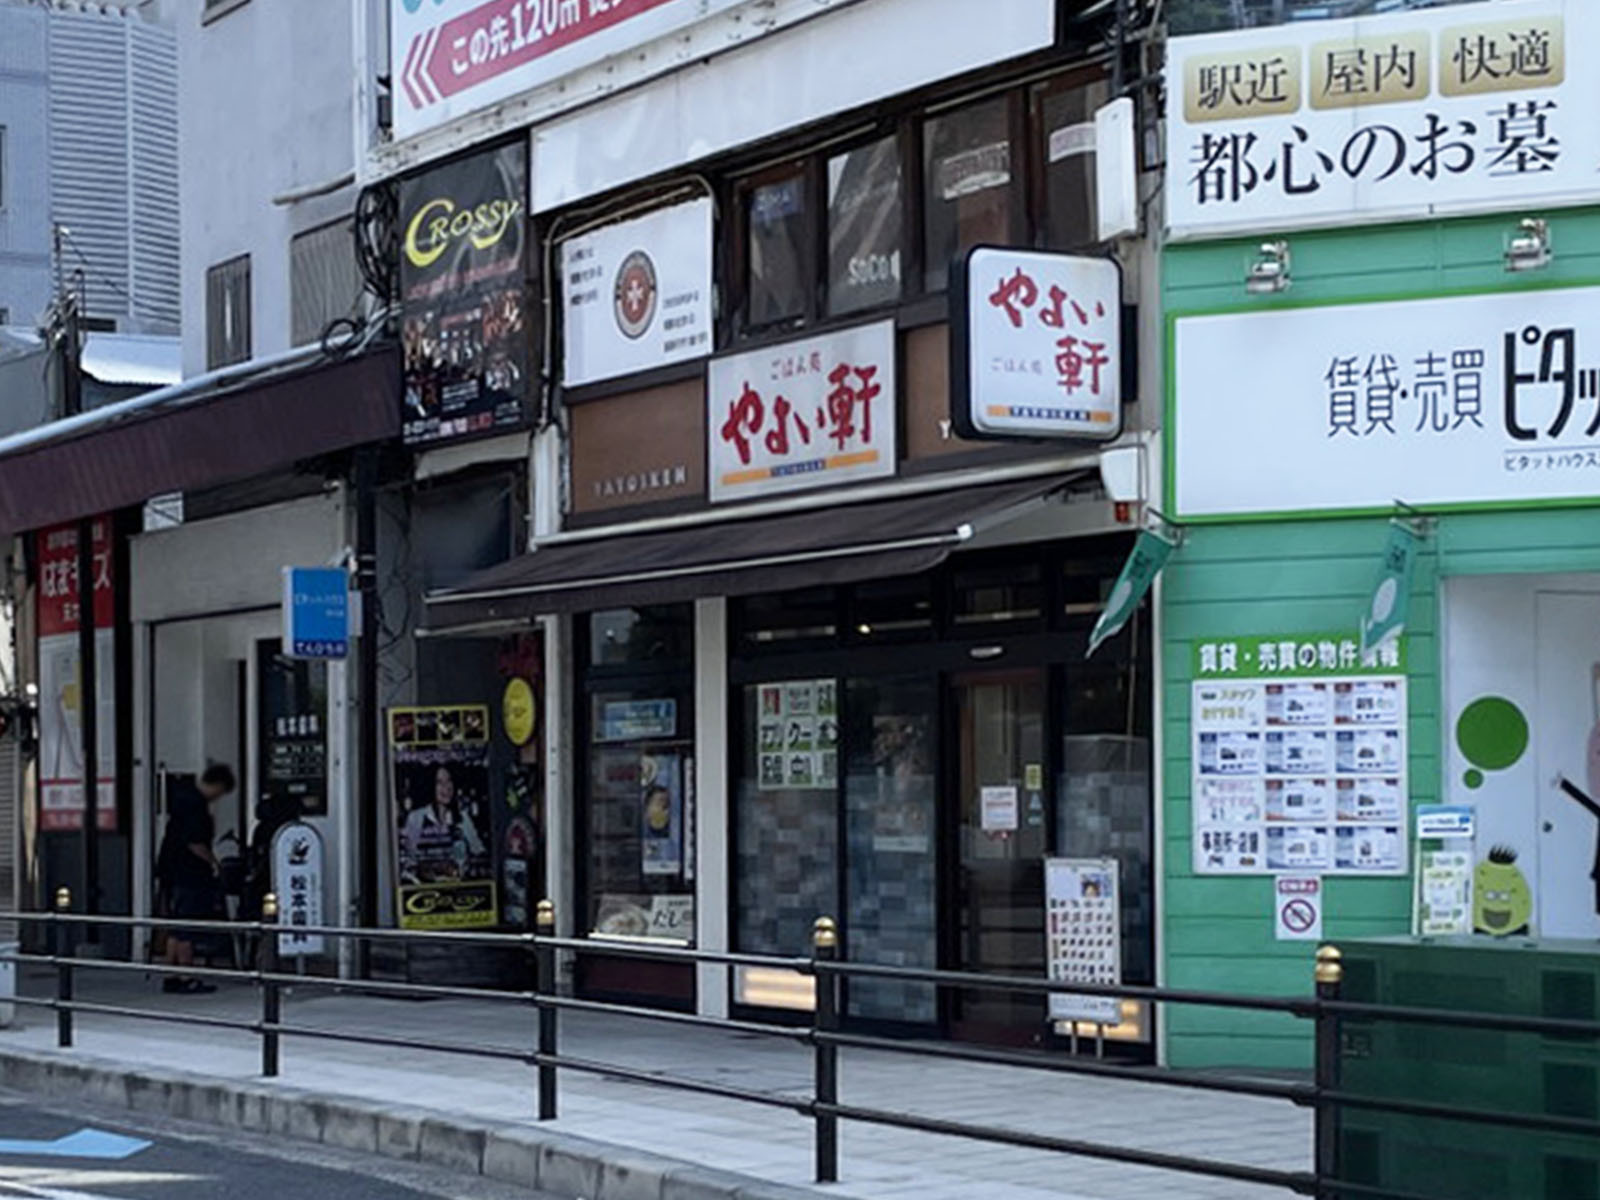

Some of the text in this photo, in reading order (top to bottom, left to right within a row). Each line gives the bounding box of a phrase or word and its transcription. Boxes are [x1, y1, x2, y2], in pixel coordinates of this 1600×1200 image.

[1199, 30, 1552, 109] 駅近 屋内 快適
[1187, 101, 1561, 204] 都心のお墓
[989, 267, 1104, 328] やよい
[1055, 336, 1109, 395] 軒
[721, 362, 881, 465] やよい軒
